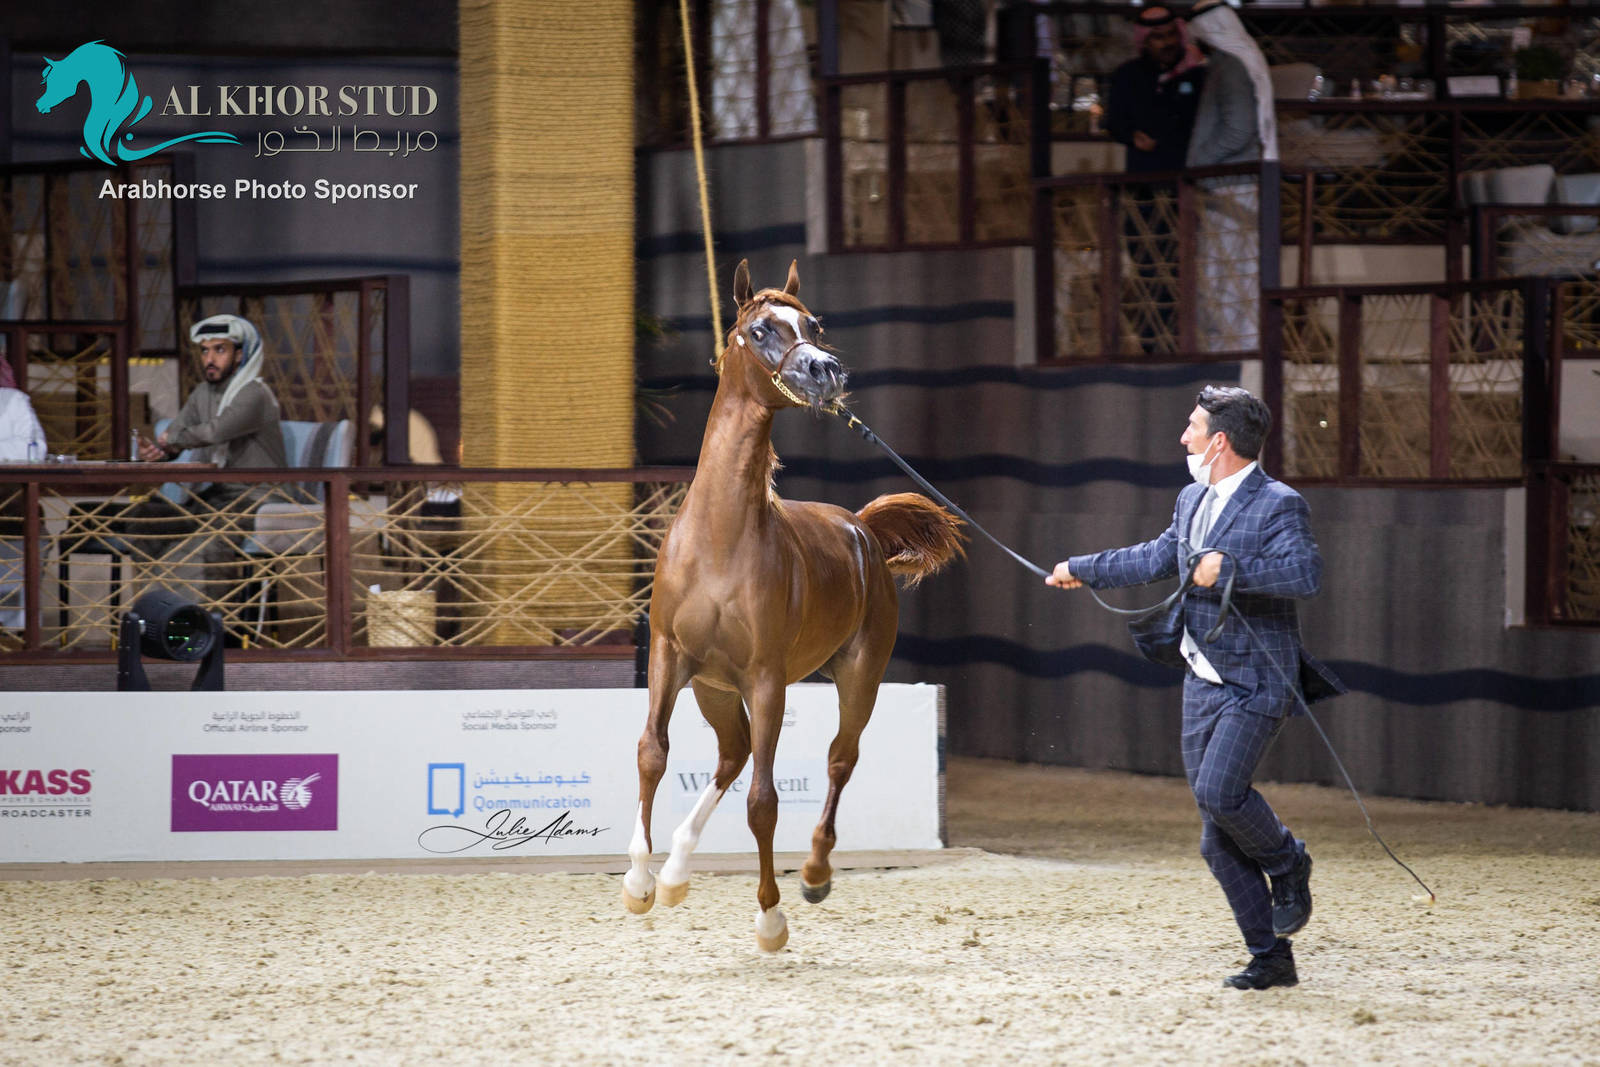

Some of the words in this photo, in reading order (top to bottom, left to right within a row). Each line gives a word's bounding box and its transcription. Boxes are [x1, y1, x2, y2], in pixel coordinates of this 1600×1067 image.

[0, 725, 32, 735] ponsor
[202, 723, 236, 733] Official
[239, 723, 269, 733] Airline
[271, 723, 308, 734] Sponsor
[461, 722, 489, 731] Social
[491, 722, 518, 731] Media
[520, 721, 557, 732] Sponsor
[188, 780, 279, 807] QATAR
[473, 795, 592, 813] Qommunication
[0, 809, 91, 818] ROADCASTER
